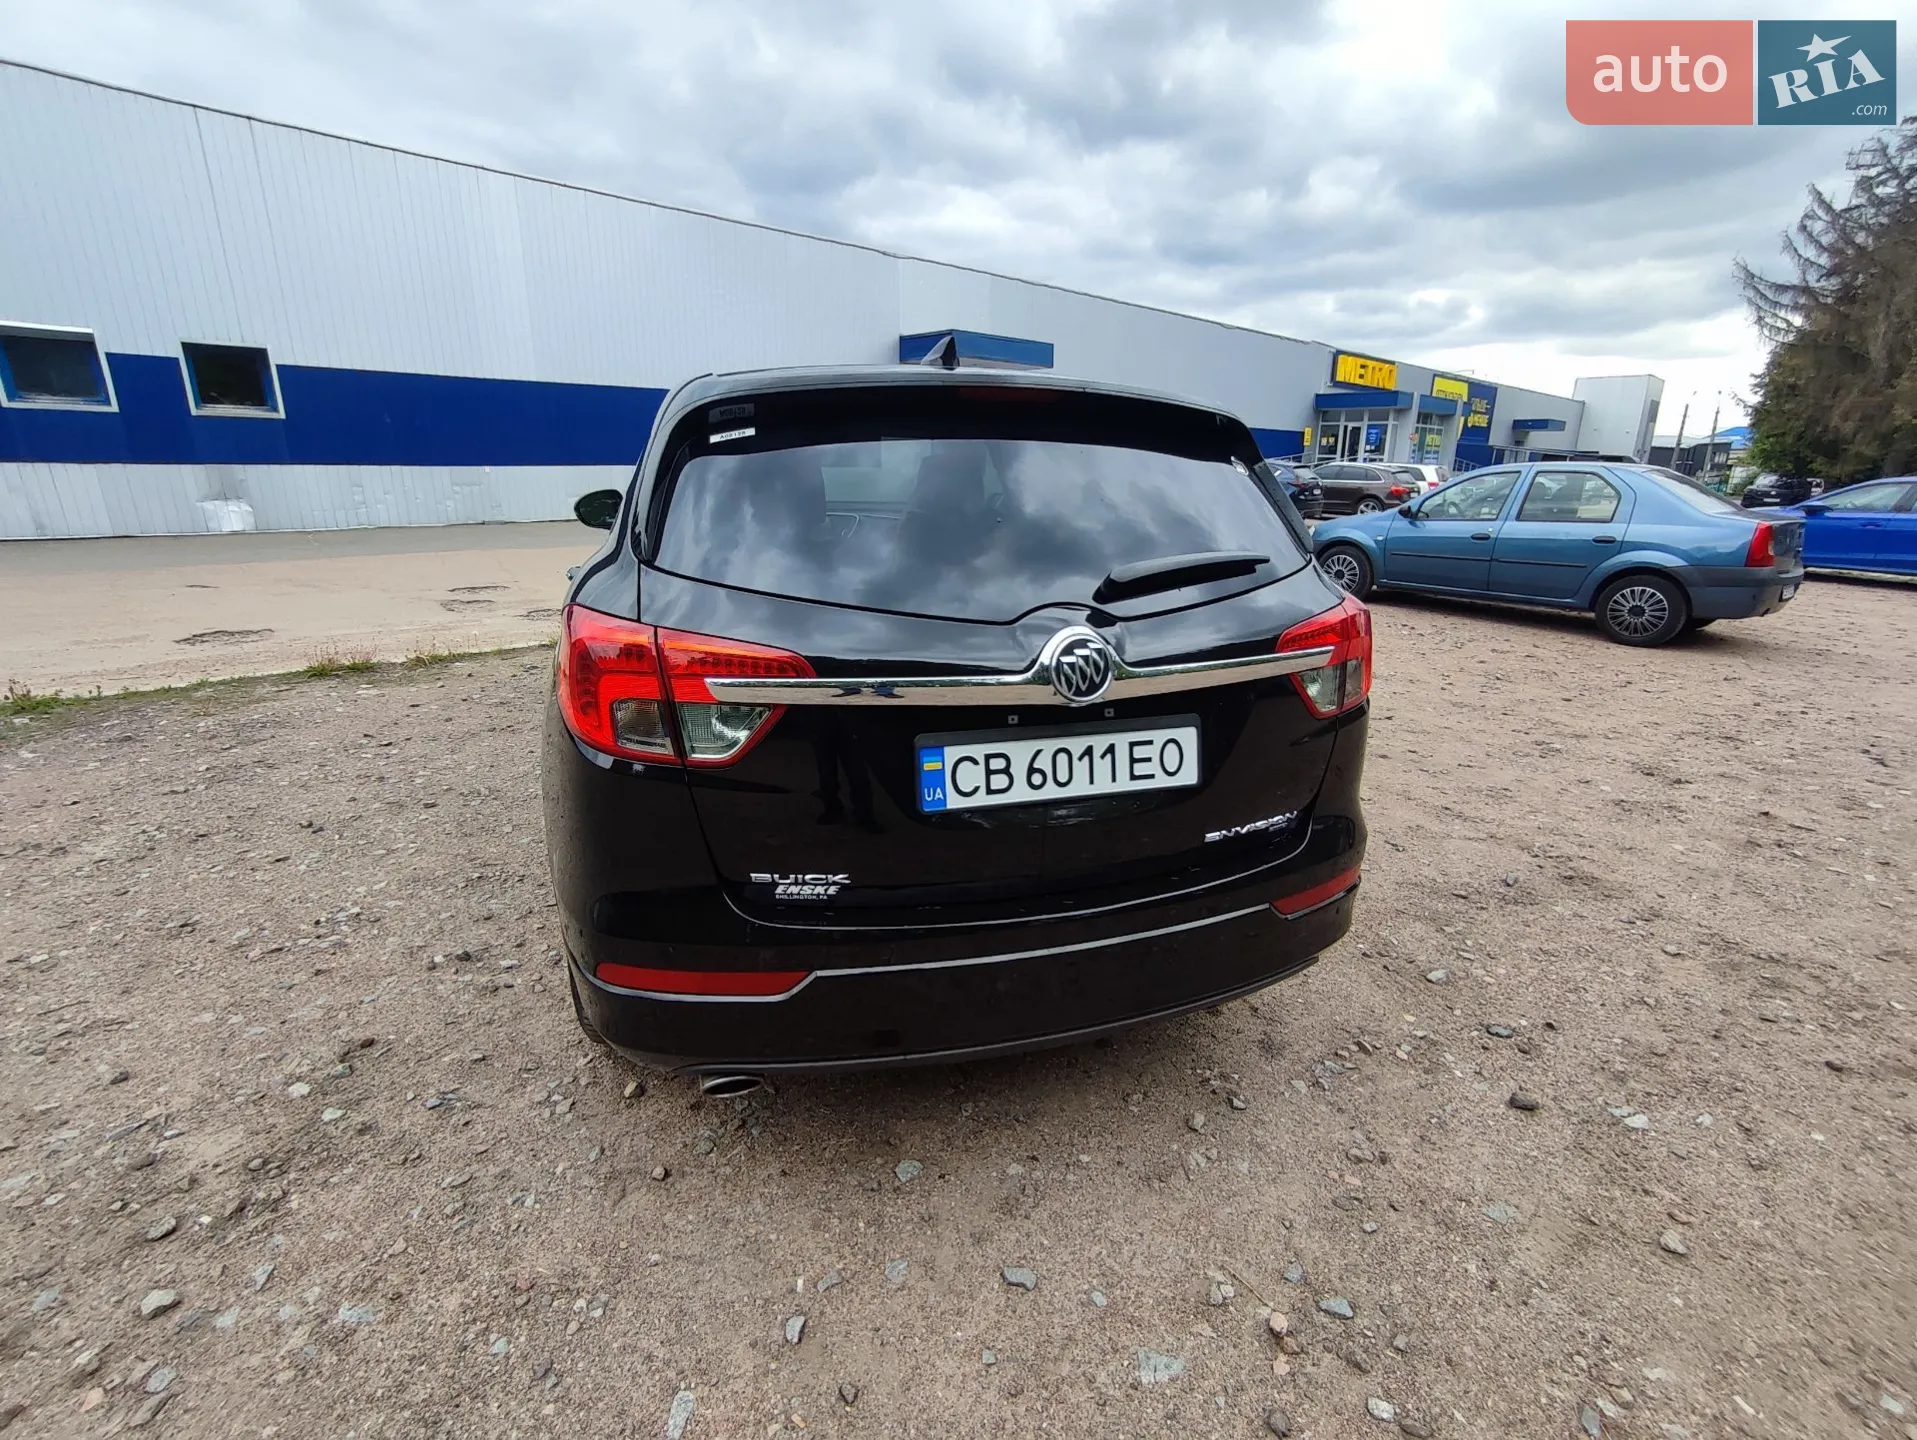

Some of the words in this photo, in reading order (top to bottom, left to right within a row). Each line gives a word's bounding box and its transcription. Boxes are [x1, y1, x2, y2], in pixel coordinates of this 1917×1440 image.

[1336, 354, 1397, 390] METRO
[950, 752, 1014, 797] CB
[1026, 743, 1116, 790] 6011
[924, 787, 944, 801] UA
[750, 873, 851, 884] BUICK
[774, 885, 841, 895] ENSKE
